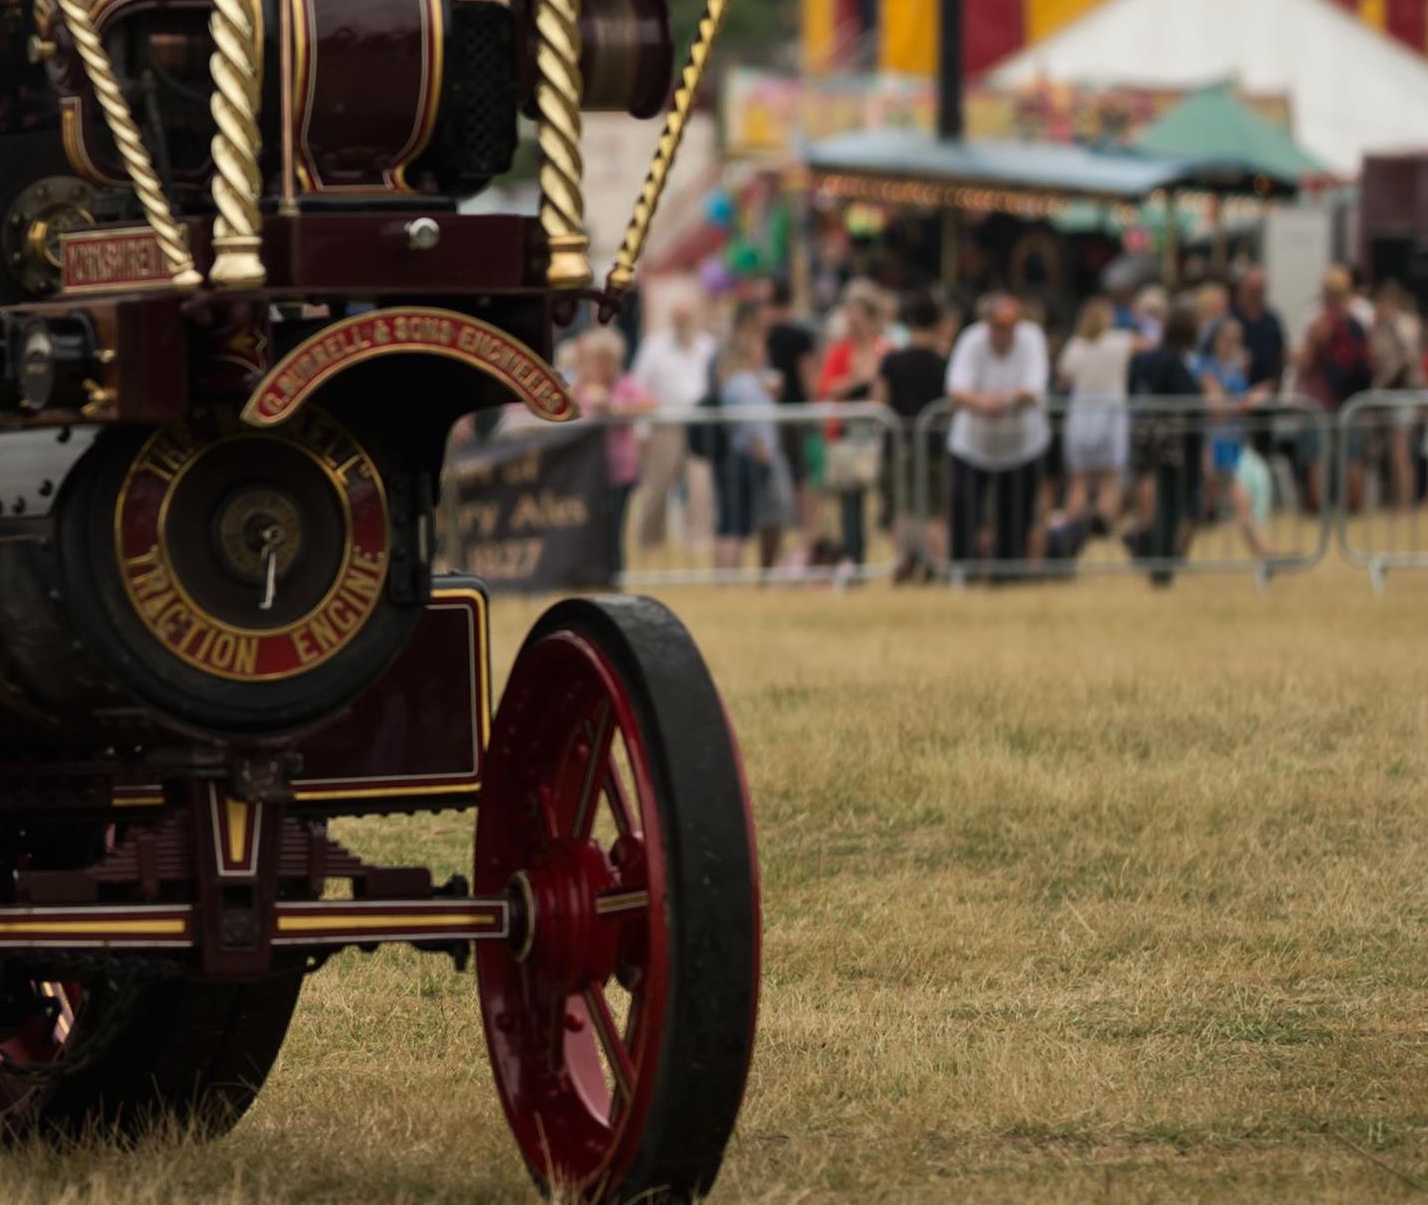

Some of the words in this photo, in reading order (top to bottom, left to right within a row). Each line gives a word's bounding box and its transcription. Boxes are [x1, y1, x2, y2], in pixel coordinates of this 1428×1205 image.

[394, 316, 453, 343] SONS
[126, 545, 260, 675] TRACTION
[291, 545, 385, 665] ENGINE
